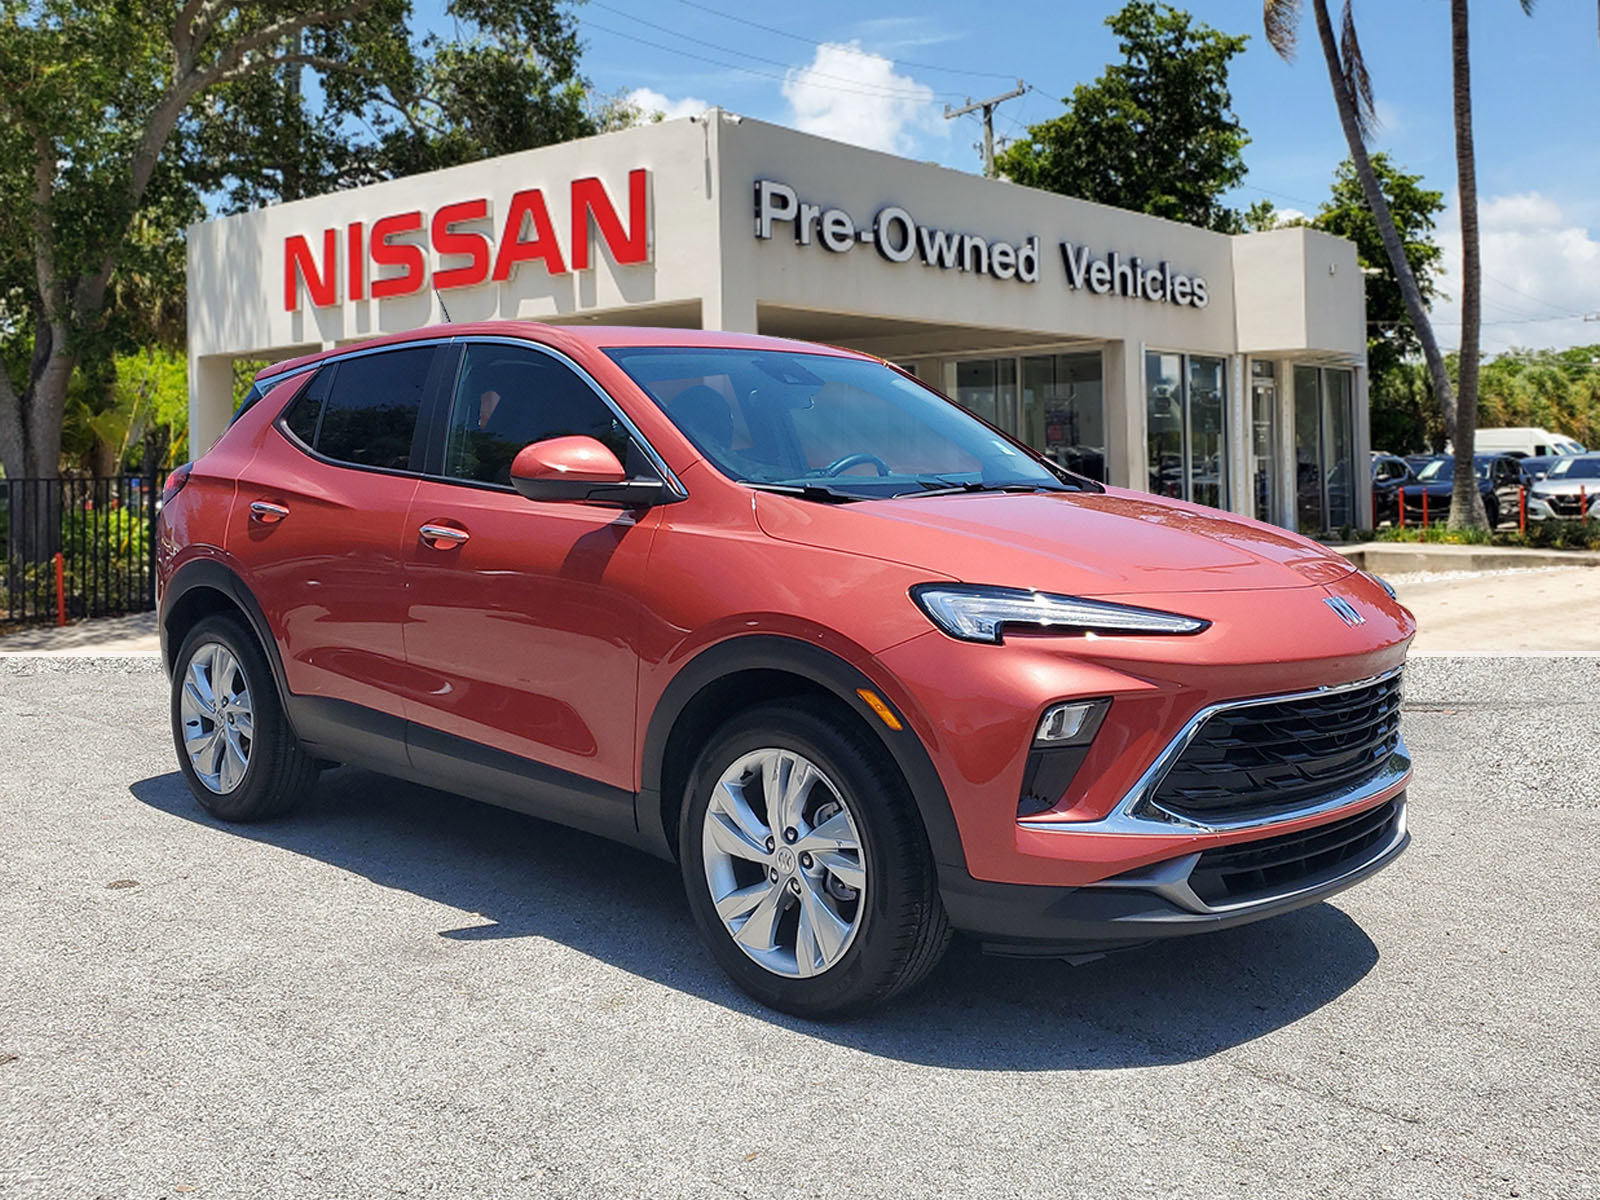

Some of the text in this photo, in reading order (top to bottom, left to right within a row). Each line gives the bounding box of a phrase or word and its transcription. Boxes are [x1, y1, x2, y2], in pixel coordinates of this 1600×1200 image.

[285, 168, 648, 311] NISSAN
[756, 180, 1209, 308] Pre-Owned Vehicles
